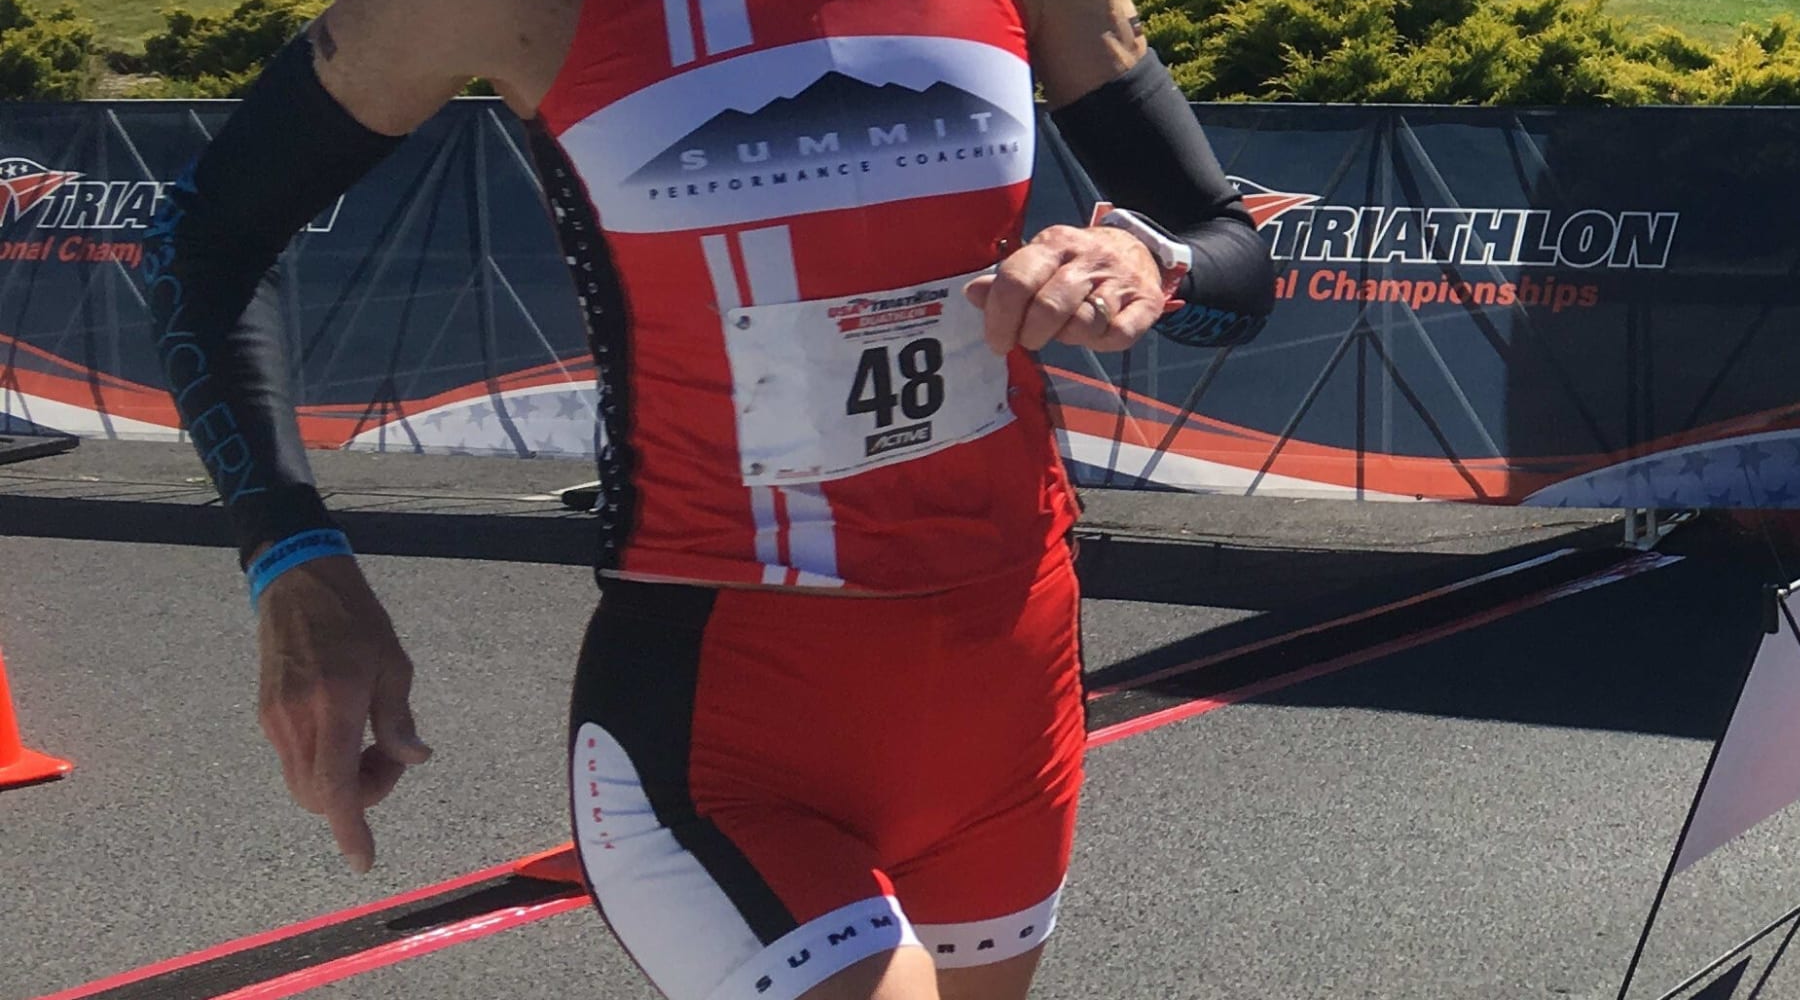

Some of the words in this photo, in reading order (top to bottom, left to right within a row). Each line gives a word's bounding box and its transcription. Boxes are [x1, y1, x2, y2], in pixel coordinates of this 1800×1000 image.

[680, 111, 993, 171] SUMMIT
[649, 160, 871, 200] PERFORMANCE
[1269, 206, 1679, 269] TRIATHLON
[1307, 269, 1600, 310] Championships
[846, 337, 945, 429] 48
[870, 428, 930, 451] ACTIVE
